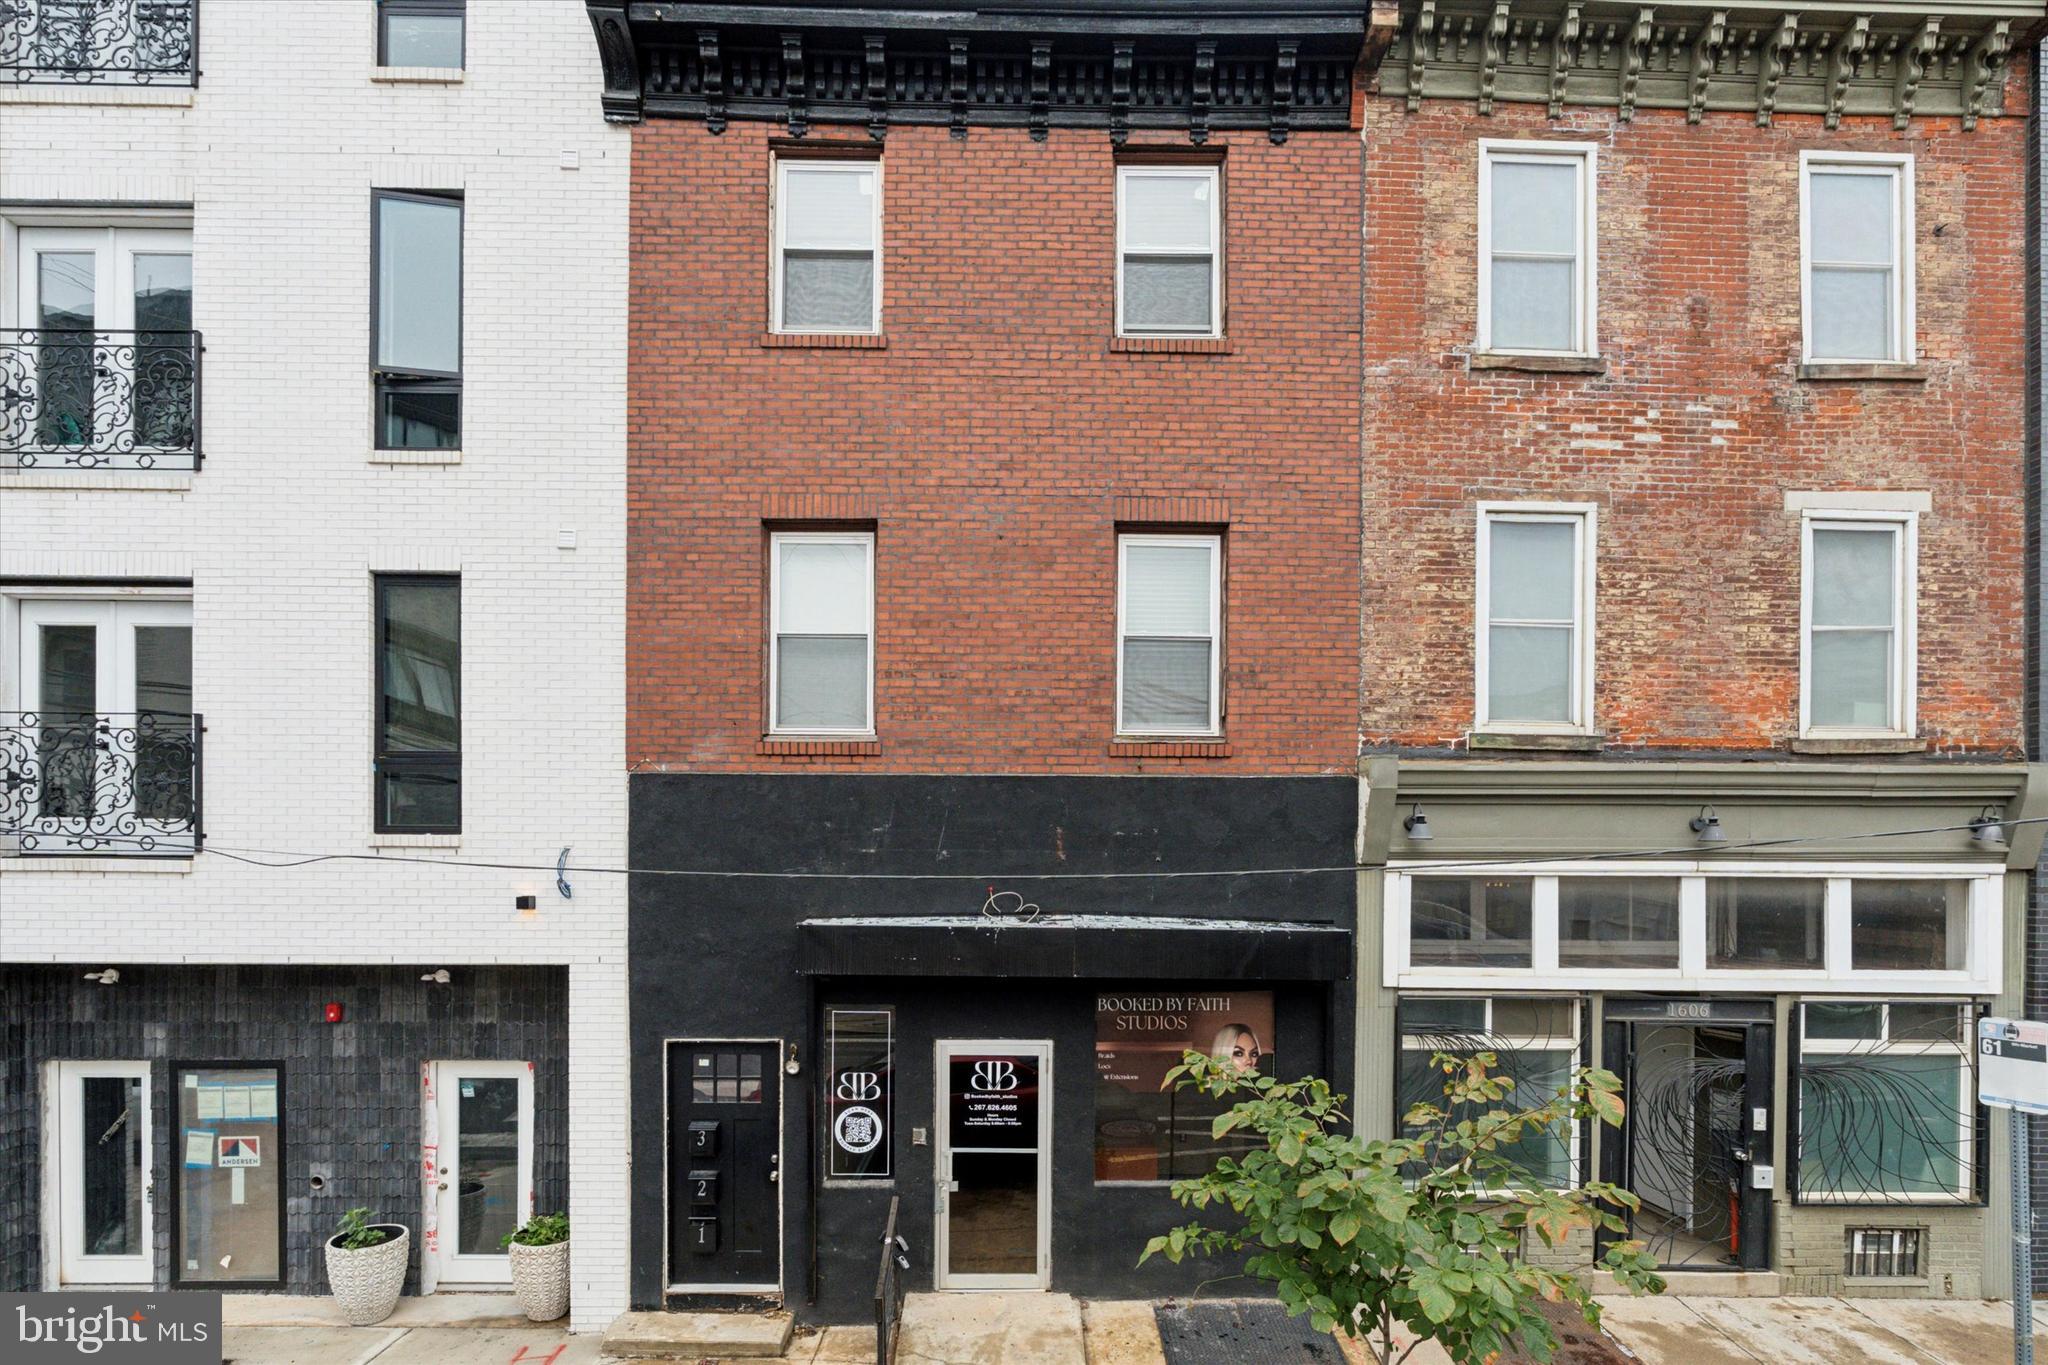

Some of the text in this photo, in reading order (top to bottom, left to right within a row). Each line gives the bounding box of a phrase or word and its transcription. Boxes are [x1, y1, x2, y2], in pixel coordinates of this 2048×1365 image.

[1098, 997, 1230, 1012] BOOKED BY FAITH
[1667, 1002, 1708, 1017] 1606
[1116, 1015, 1188, 1031] STUDIOS
[1982, 1038, 2001, 1056] 61
[697, 1130, 706, 1146] 3
[697, 1180, 707, 1196] 2
[698, 1223, 705, 1243] 1
